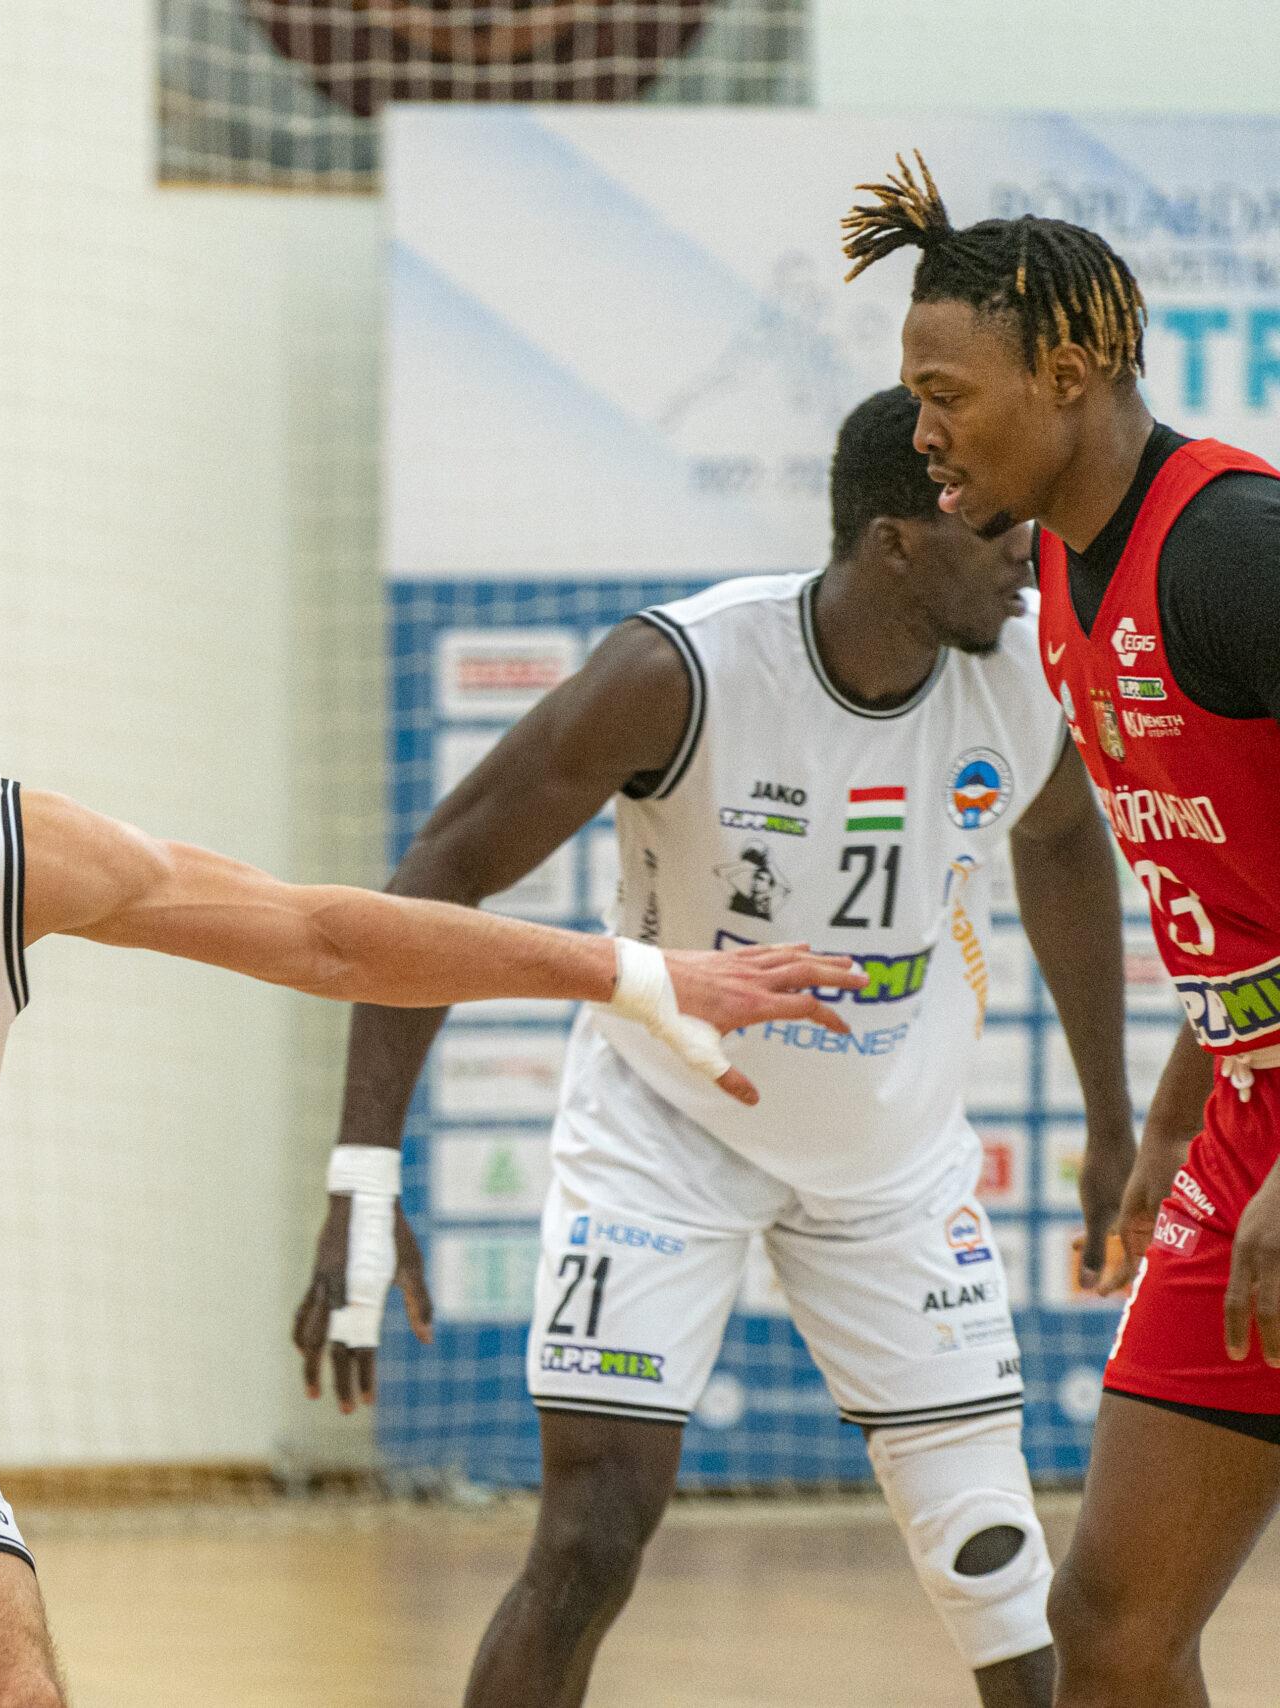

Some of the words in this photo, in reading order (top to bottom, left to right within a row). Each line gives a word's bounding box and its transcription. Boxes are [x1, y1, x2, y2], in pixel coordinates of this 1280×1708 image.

[1124, 634, 1156, 652] EGIS
[751, 781, 807, 806] JAKO
[831, 845, 903, 928] 21
[548, 1254, 611, 1338] 21
